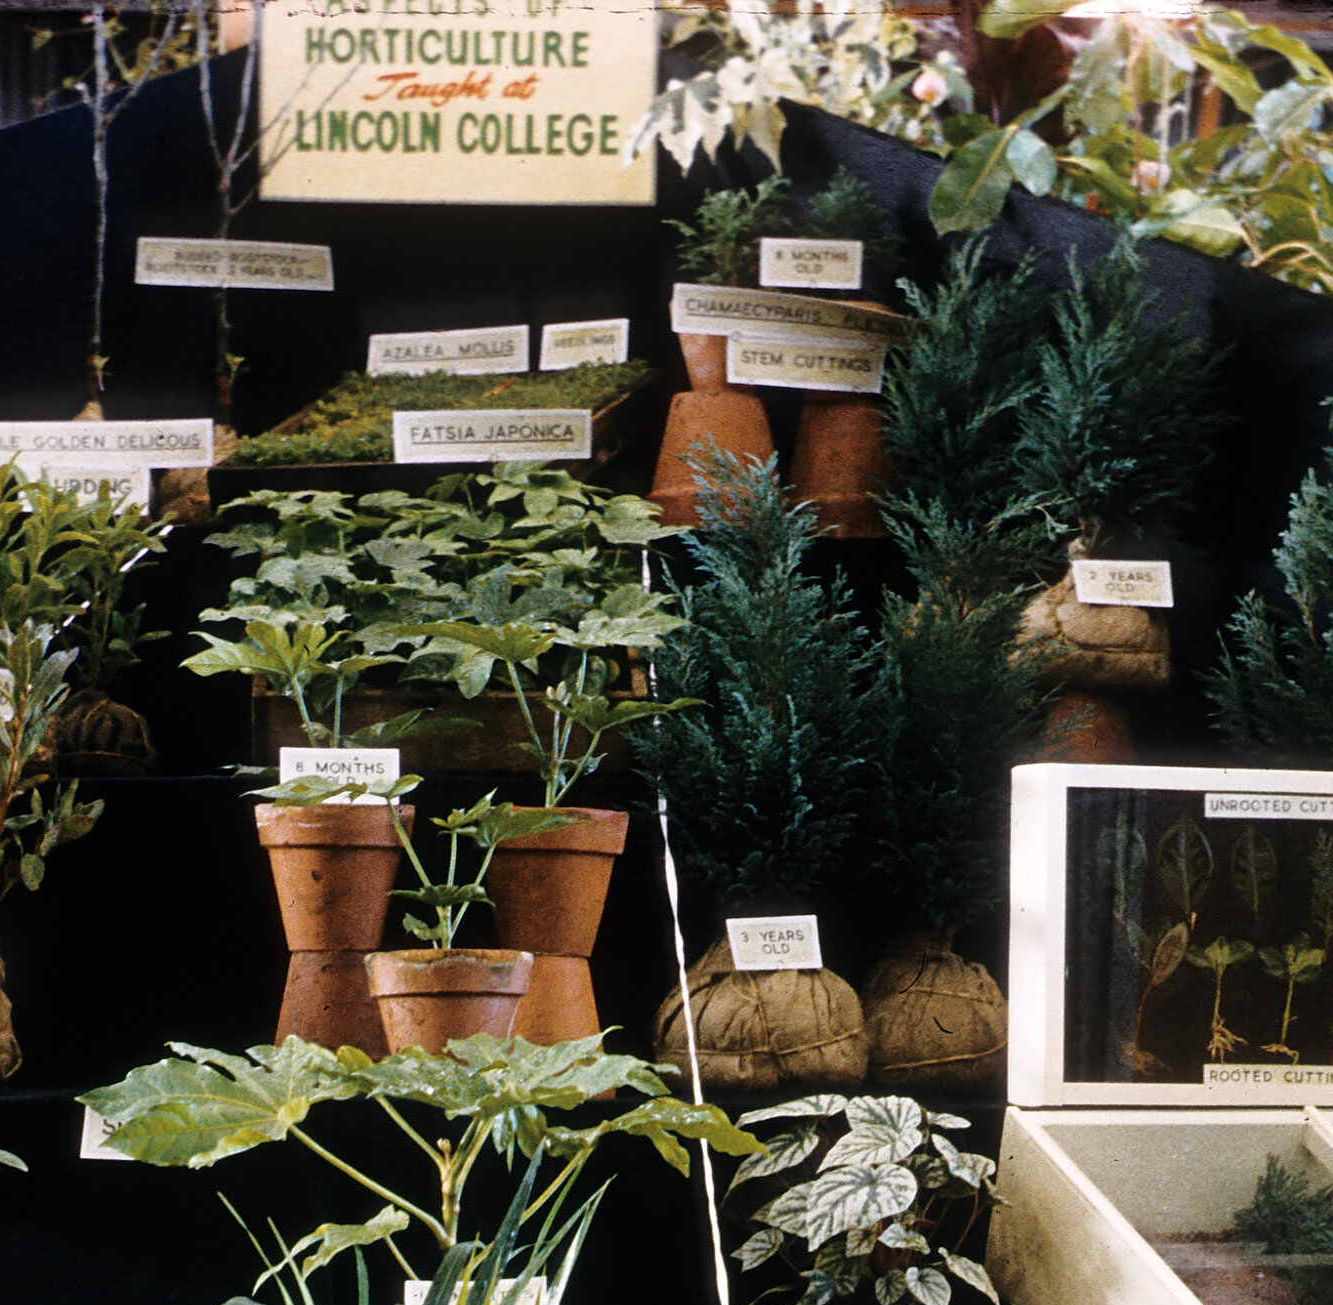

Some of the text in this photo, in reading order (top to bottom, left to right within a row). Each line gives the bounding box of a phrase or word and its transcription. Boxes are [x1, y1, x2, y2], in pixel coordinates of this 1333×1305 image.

[305, 28, 589, 67] HORTICULTURE
[363, 70, 539, 107] Taught at
[296, 110, 618, 155] LINCOLN COLLEGE
[791, 250, 850, 263] MONTHS
[795, 263, 822, 273] OLD
[685, 298, 822, 322] CHAMAECYPARIS
[383, 340, 514, 359] AZALEA MOLLIS
[741, 351, 872, 372] STEM CUTTINGS
[410, 424, 574, 440] FATSIA JAPONICA
[33, 435, 105, 449] GOLDEN
[1089, 571, 1153, 583] 2 YEARS
[1106, 583, 1135, 592] OLD
[316, 762, 385, 774] MONTHS
[1210, 799, 1291, 812] UNROOTED
[740, 930, 804, 943] 3 YEARS
[762, 944, 790, 954] OLD
[1209, 1070, 1273, 1083] ROOTED
